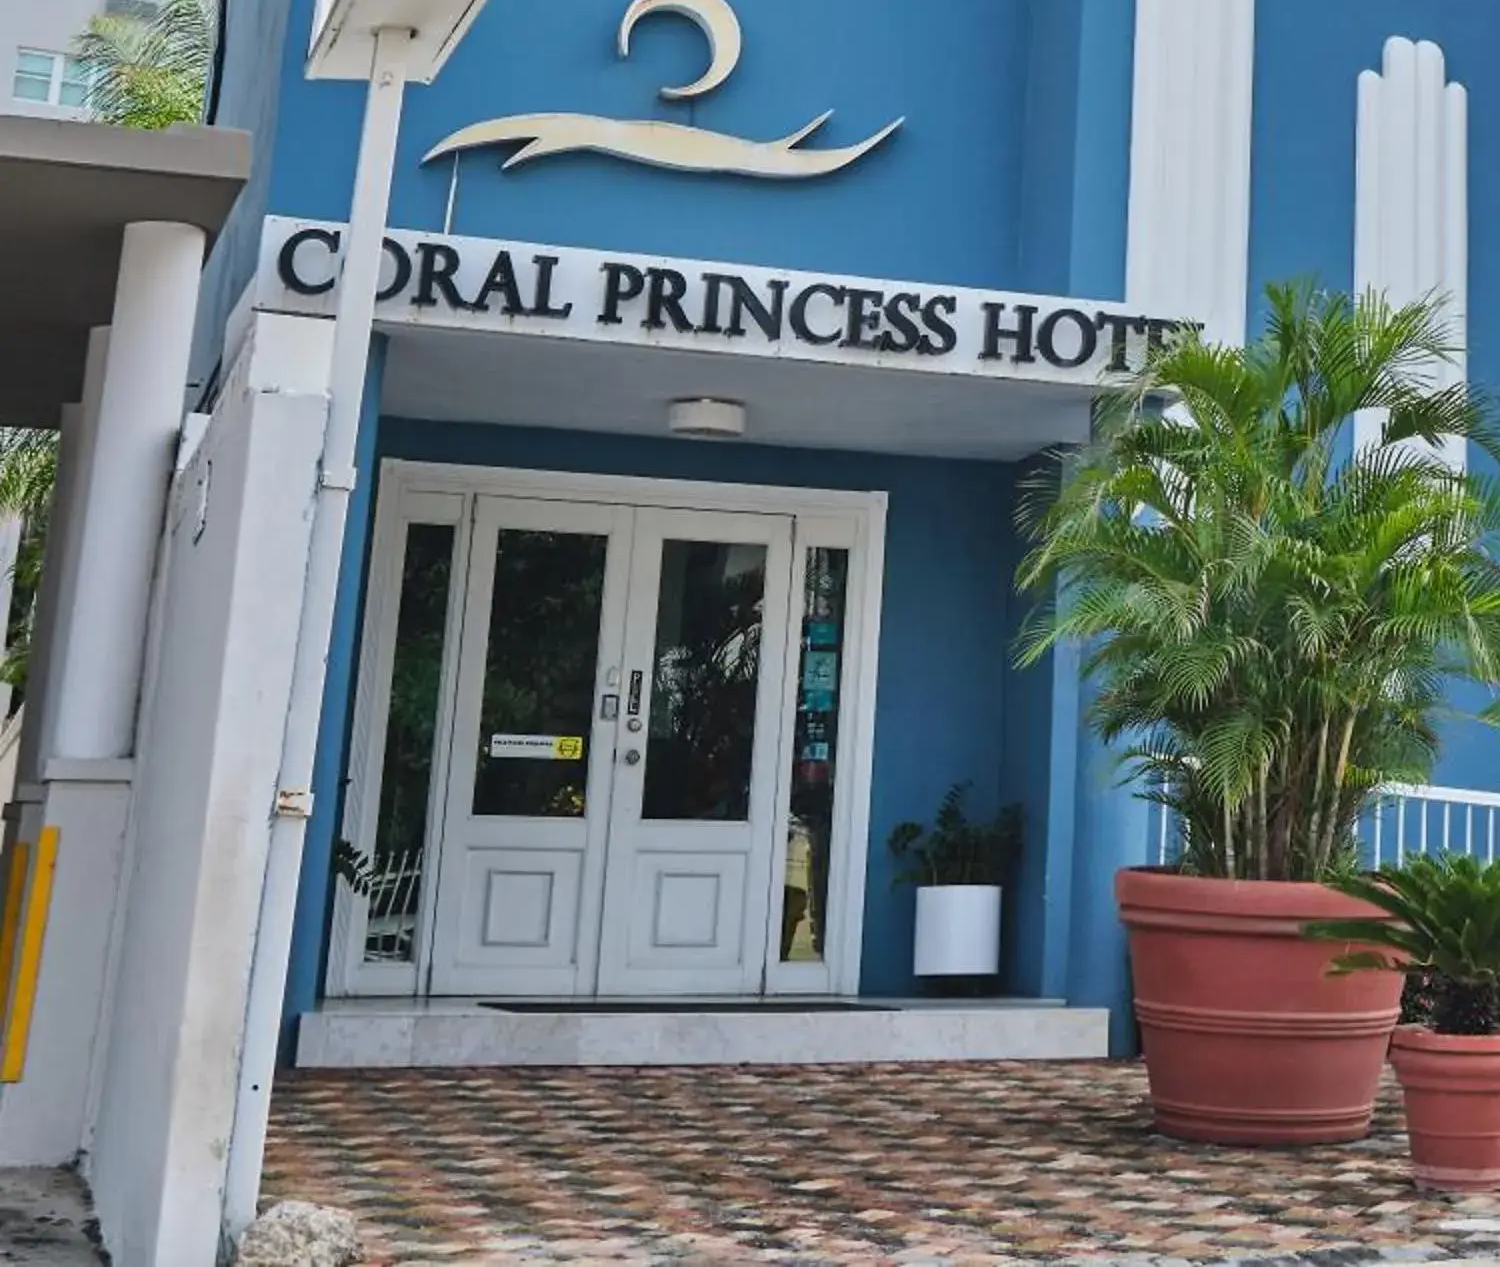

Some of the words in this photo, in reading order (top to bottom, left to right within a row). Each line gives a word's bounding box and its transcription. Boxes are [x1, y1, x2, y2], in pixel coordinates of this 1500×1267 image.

[278, 228, 573, 319] CORAL
[596, 262, 957, 355] PRINCESS
[978, 301, 1205, 372] HOT
[630, 672, 641, 713] PLL
